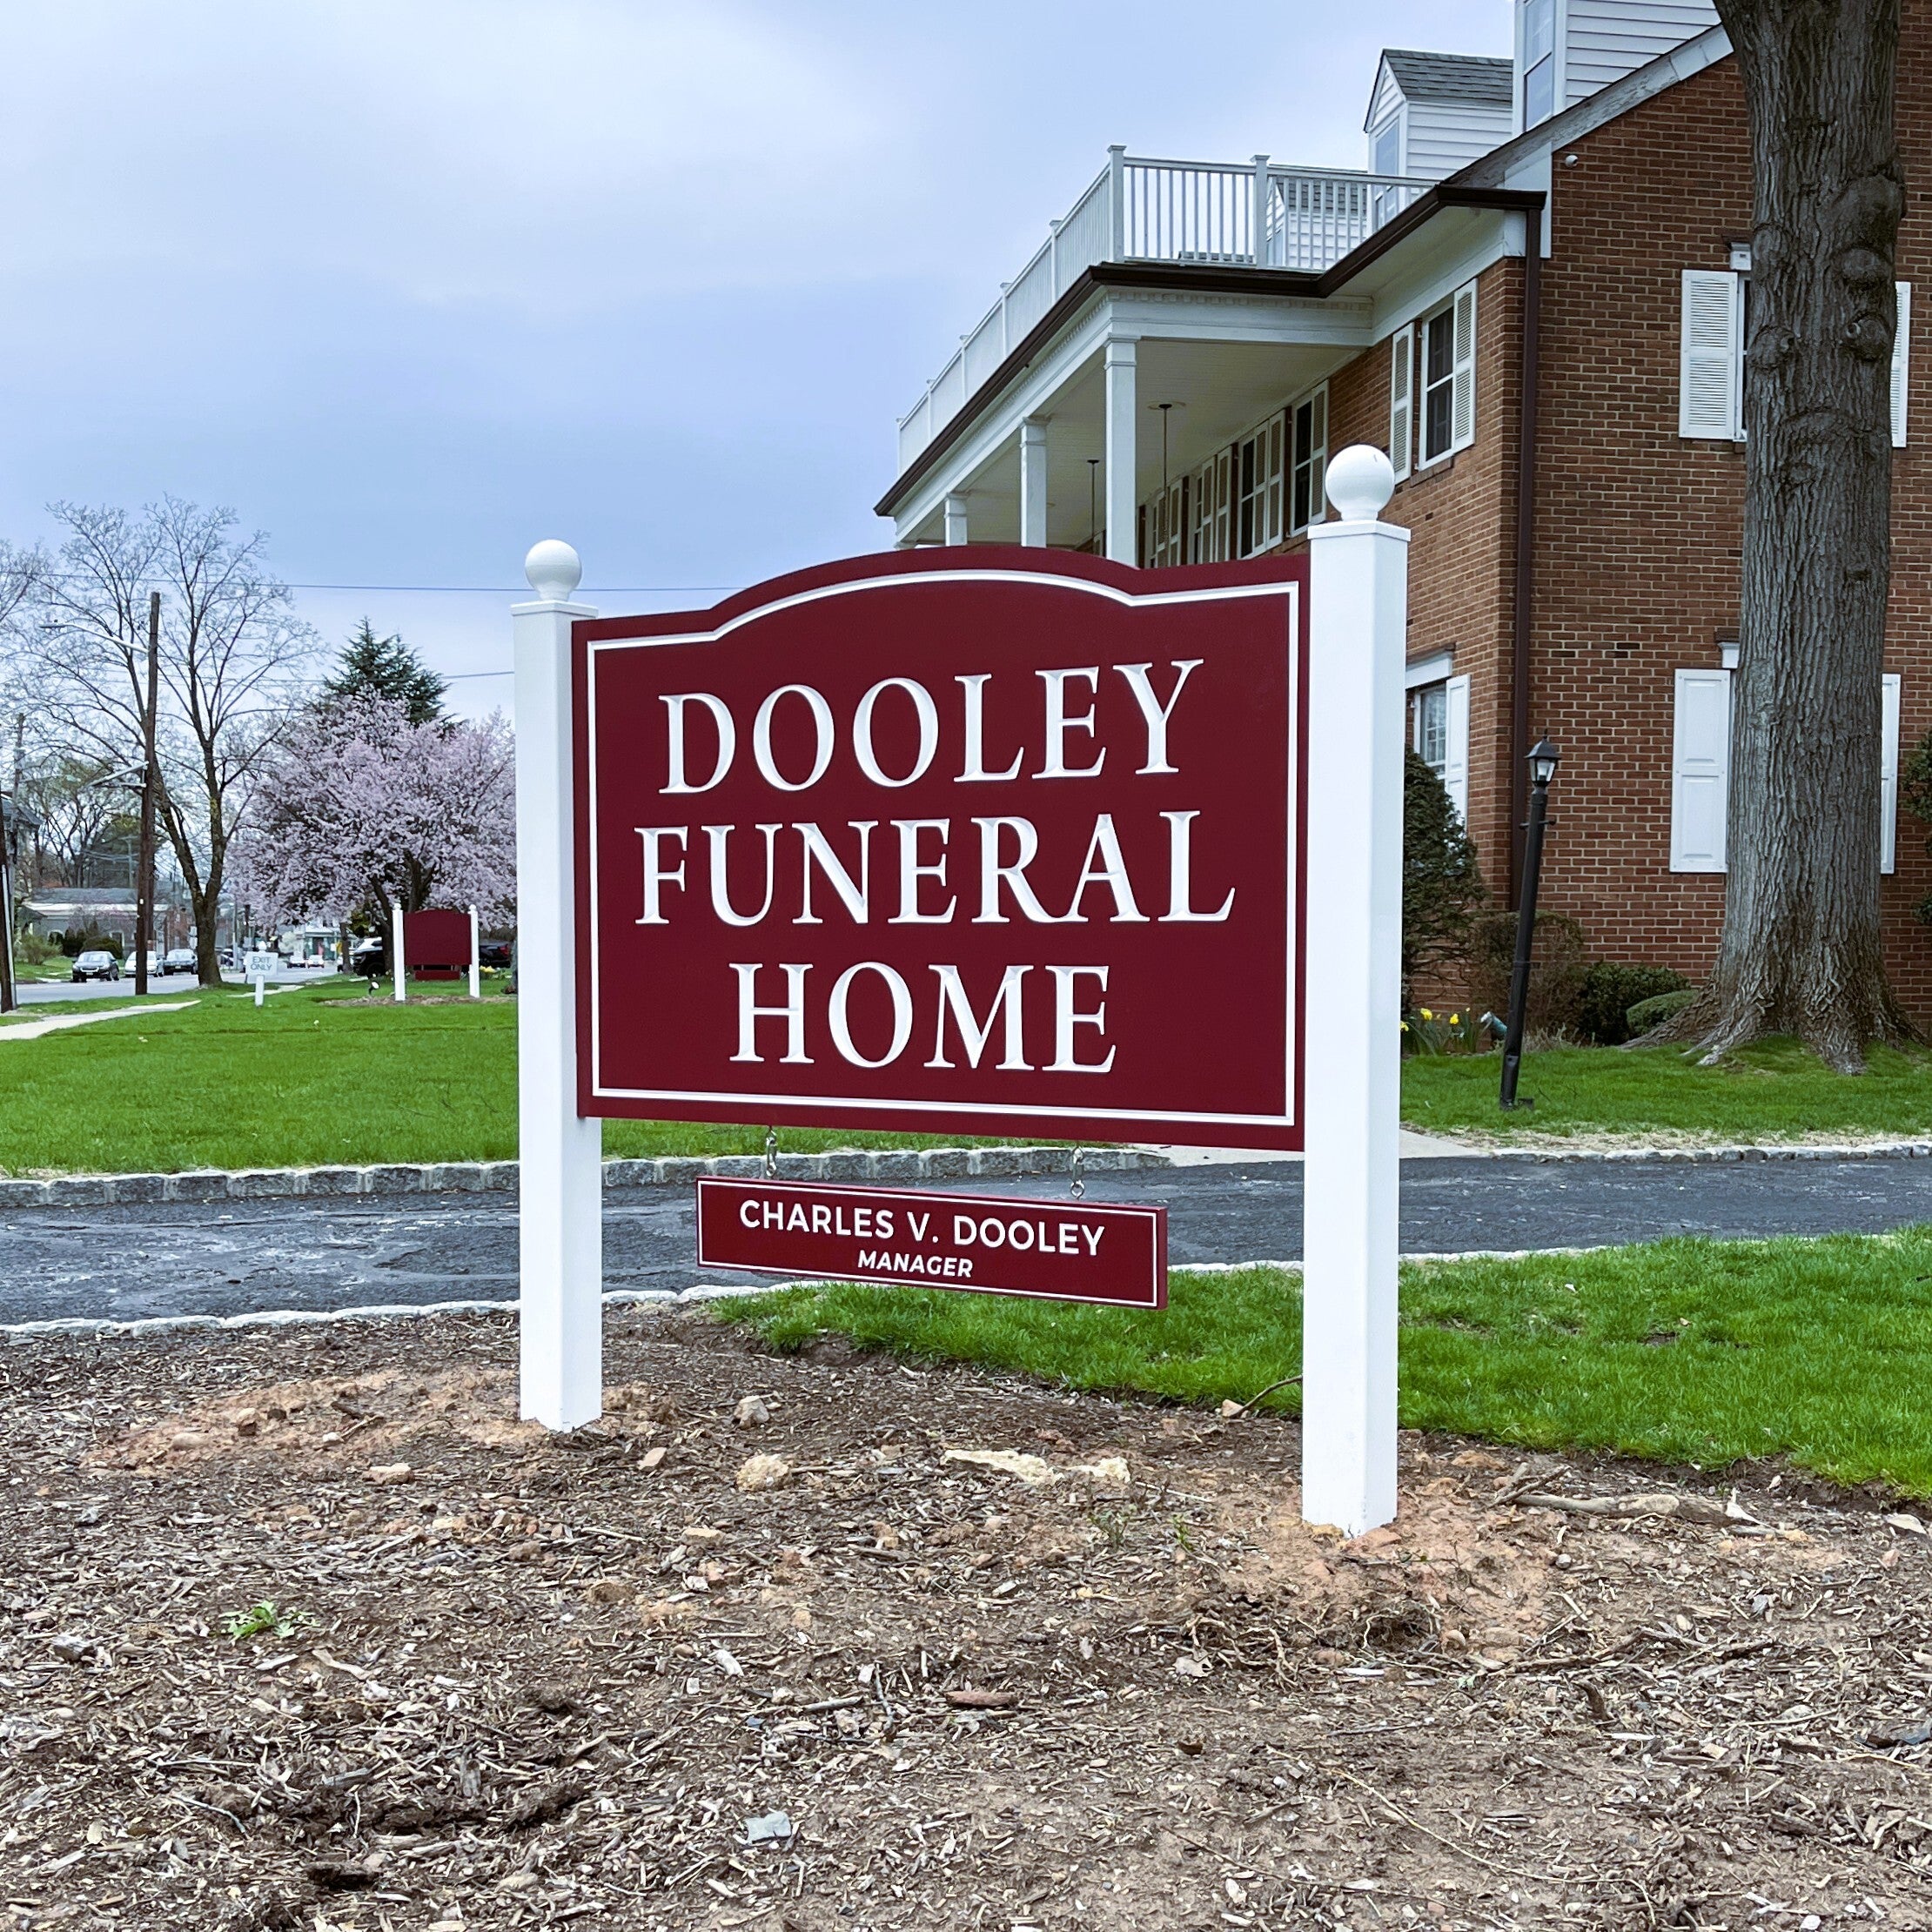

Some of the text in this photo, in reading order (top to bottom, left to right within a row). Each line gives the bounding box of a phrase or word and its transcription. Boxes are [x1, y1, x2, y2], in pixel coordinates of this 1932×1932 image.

[658, 658, 1204, 794] DOOLEY
[634, 810, 1236, 927] FUNERAL
[728, 961, 1117, 1073] HOME
[740, 1199, 1105, 1256] CHARLES V. DOOLEY
[857, 1250, 973, 1278] MANAGER
